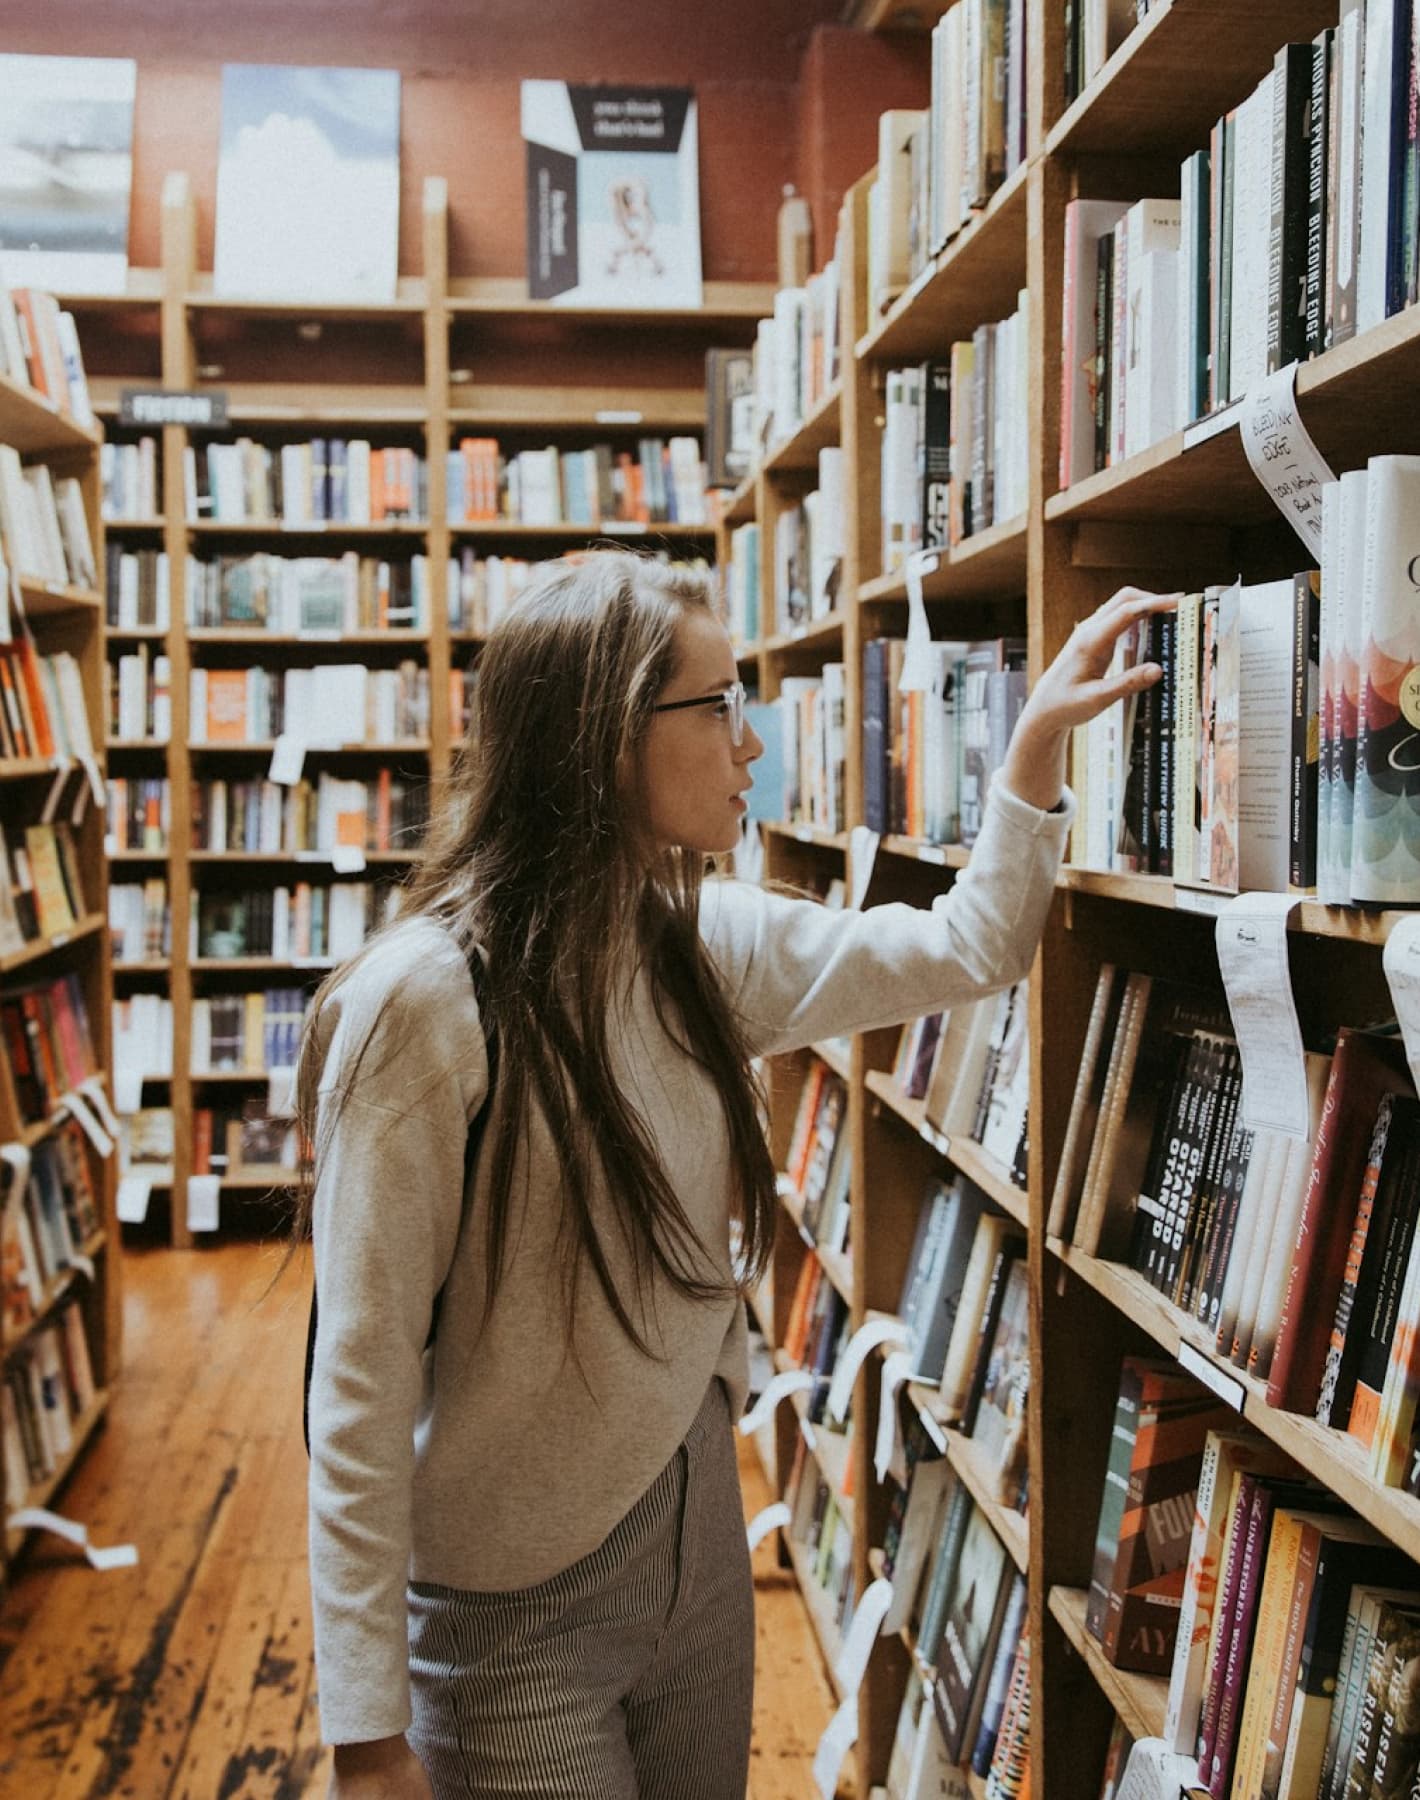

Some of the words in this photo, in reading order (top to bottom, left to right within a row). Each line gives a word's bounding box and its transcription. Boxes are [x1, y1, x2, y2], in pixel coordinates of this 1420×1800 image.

[1310, 48, 1324, 120] THOMAS
[1308, 124, 1322, 203] PYNCHON
[1268, 227, 1281, 304] BLEEDING
[1306, 215, 1320, 294] BLEEDING
[1267, 311, 1279, 351] EDGE
[1305, 299, 1318, 342] EDGE
[1295, 586, 1306, 673] Monument
[1161, 692, 1169, 721] FAIL
[1294, 678, 1304, 717] Road
[1357, 673, 1368, 750] MILLER'S
[1160, 741, 1169, 807] MATTHEW
[1159, 808, 1168, 849] QUICK
[1318, 1097, 1335, 1147] Devil
[1313, 1144, 1322, 1160] in
[1162, 1142, 1190, 1244] OTARED
[1172, 1148, 1200, 1251] OTARED
[1217, 1194, 1227, 1220] Tom
[1228, 1200, 1238, 1225] Tom
[1295, 1164, 1320, 1250] Jerusalem
[1282, 1265, 1298, 1310] NAOMI
[1370, 1291, 1383, 1338] Childhood
[1380, 1298, 1394, 1344] Childhood
[1222, 1508, 1242, 1608] UNRESTORED
[1234, 1520, 1257, 1622] UNRESTORED
[1291, 1601, 1301, 1631] RON
[1225, 1626, 1240, 1688] WOMAN
[1284, 1634, 1297, 1672] RASH
[1370, 1636, 1388, 1681] THE
[1388, 1656, 1405, 1699] THE
[1218, 1696, 1233, 1748] SHOBHA
[1274, 1675, 1289, 1731] READER
[1355, 1692, 1376, 1764] RISEN
[1373, 1711, 1394, 1785] RISEN
